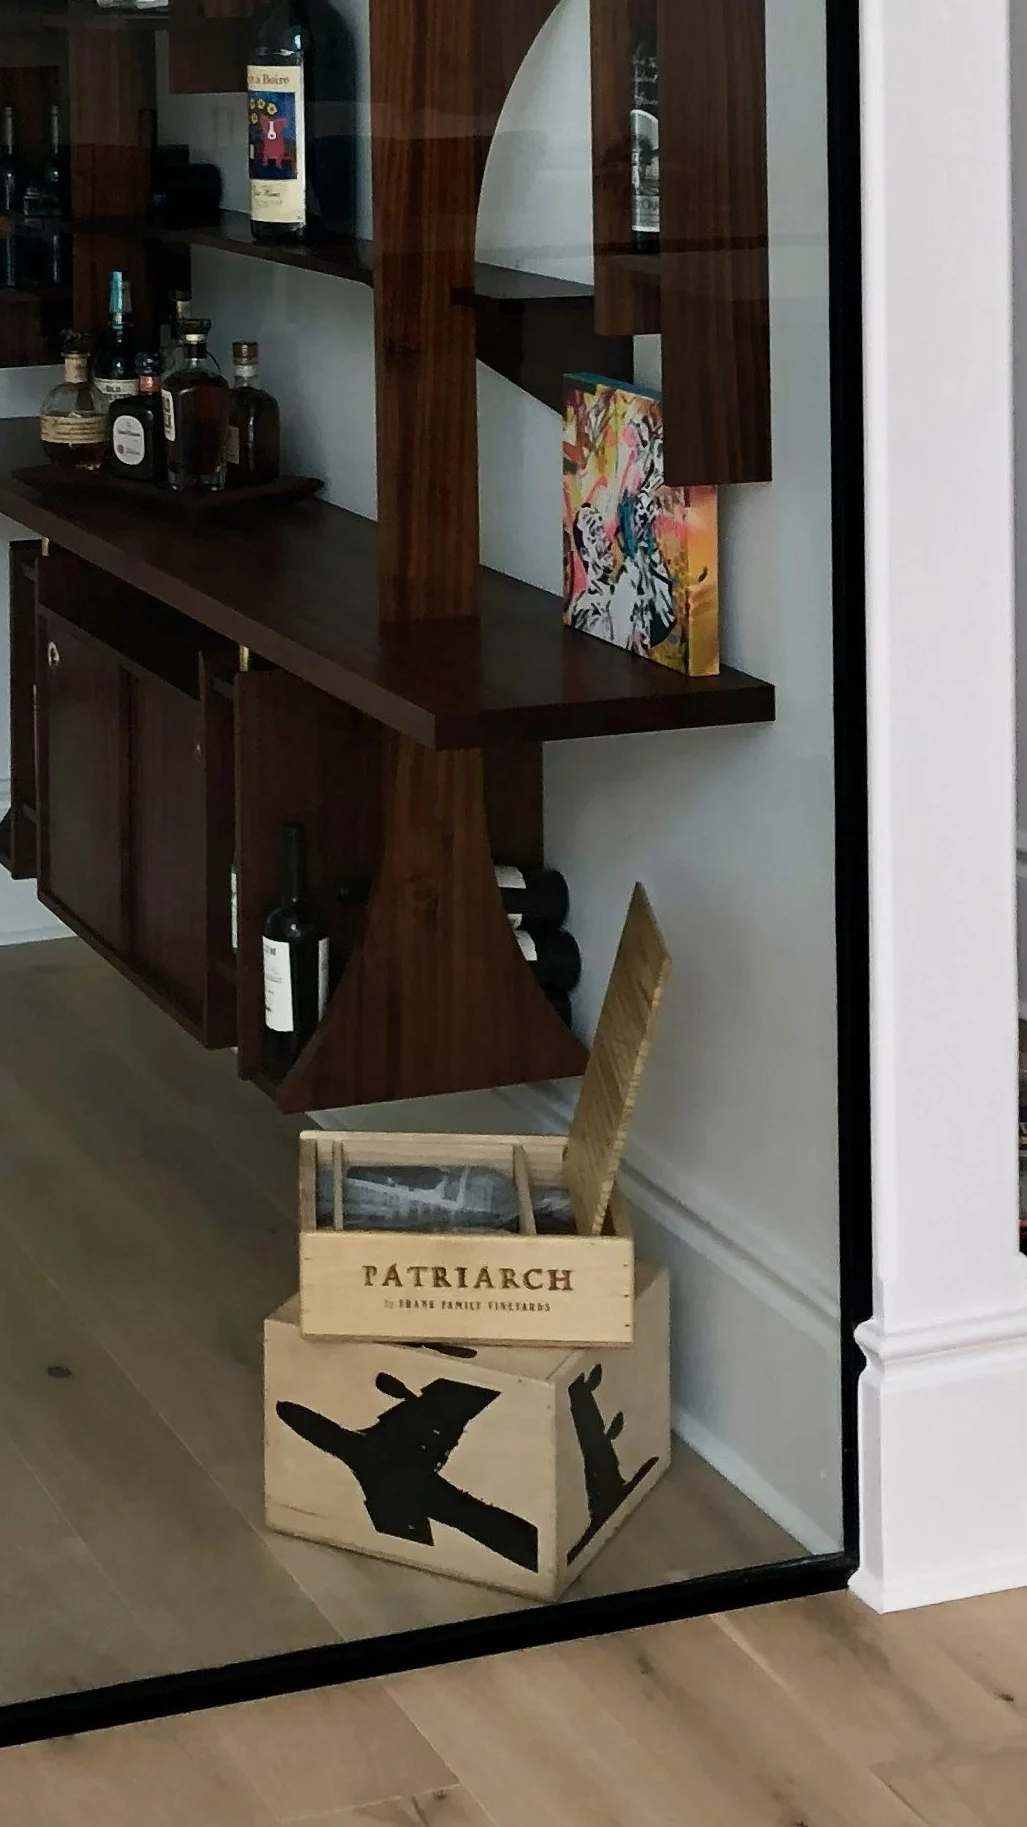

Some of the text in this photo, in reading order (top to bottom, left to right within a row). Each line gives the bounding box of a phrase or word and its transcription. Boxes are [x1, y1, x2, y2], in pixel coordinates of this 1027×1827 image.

[105, 385, 121, 393] OLD
[362, 1263, 574, 1292] PATRIARCH
[399, 1298, 435, 1310] FRANK
[441, 1299, 482, 1311] FAMILY
[488, 1300, 551, 1313] VINEYARDS
